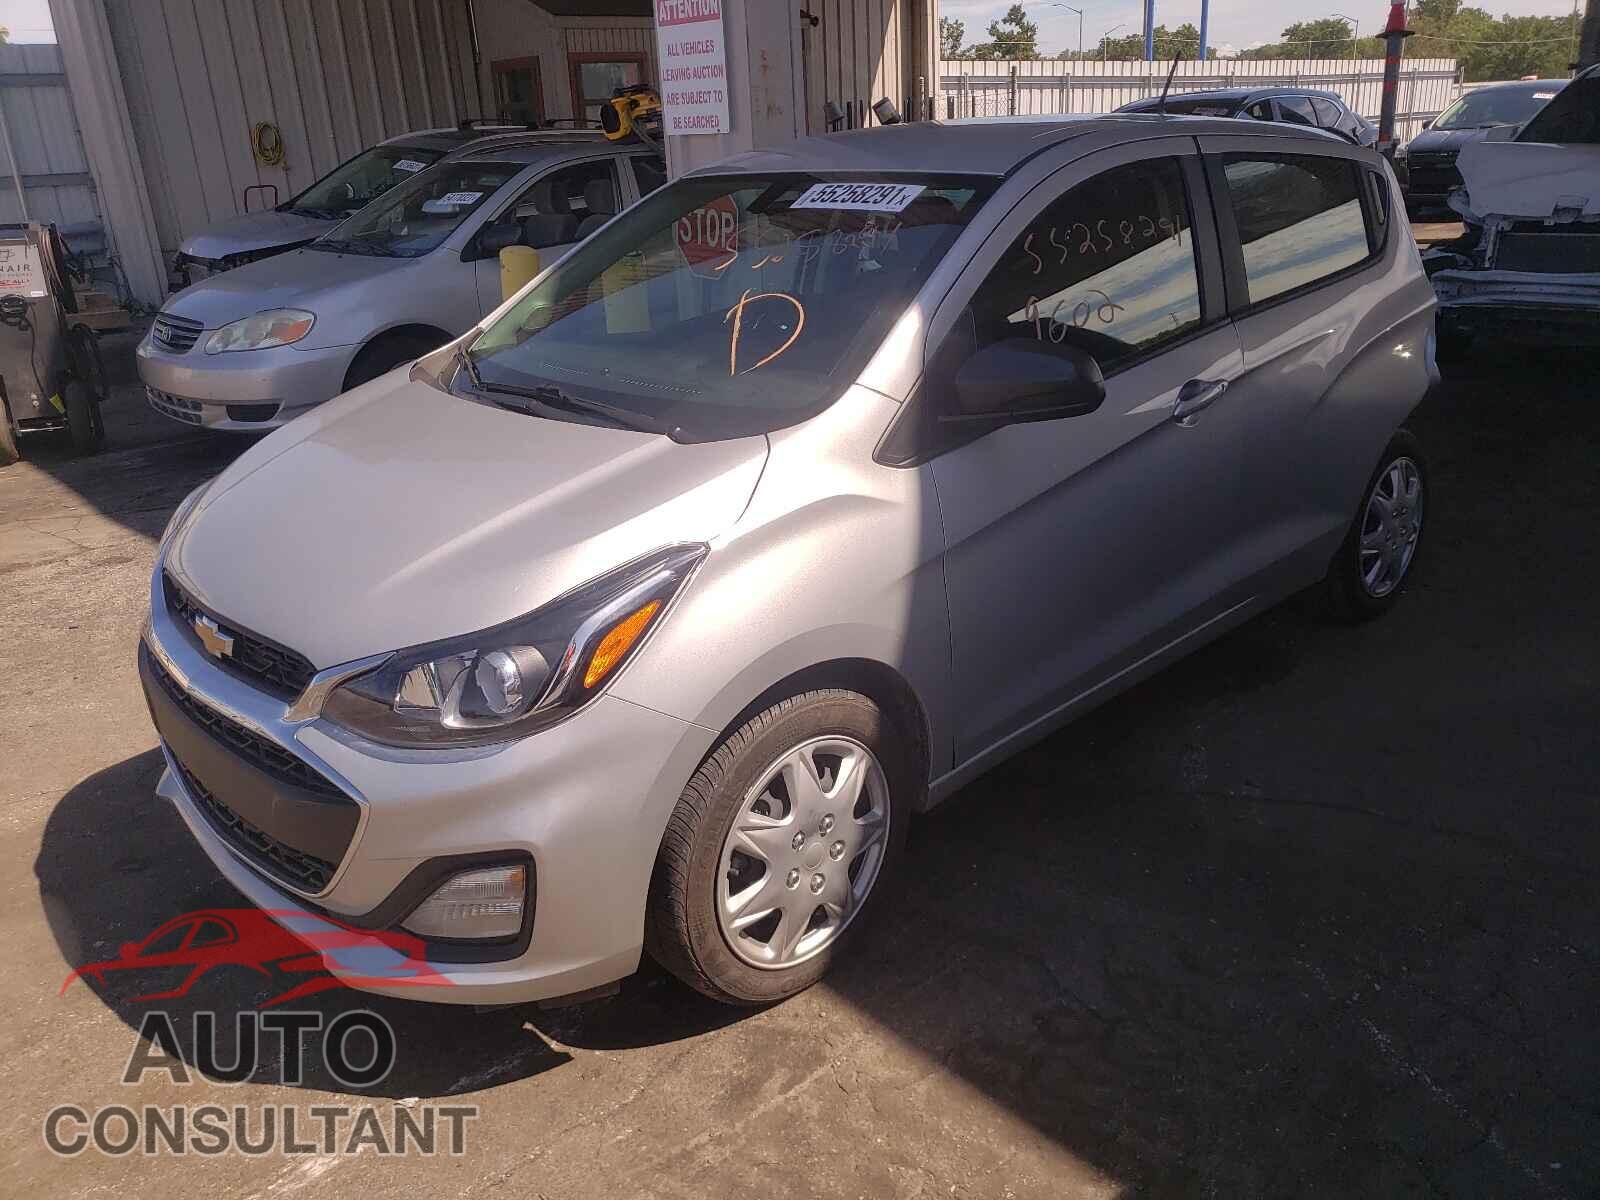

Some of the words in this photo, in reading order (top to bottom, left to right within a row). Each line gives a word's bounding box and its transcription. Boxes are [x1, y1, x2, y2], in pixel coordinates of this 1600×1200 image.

[658, 0, 720, 21] ATTENTION
[667, 43, 680, 57] ALL
[680, 40, 715, 56] VEHICLES
[662, 66, 691, 82] LEAVING
[692, 63, 724, 80] AUCTION
[666, 92, 680, 105] ARE
[681, 91, 712, 105] SUBJECT
[713, 90, 723, 103] TO
[672, 116, 683, 129] BE
[683, 114, 720, 129] SEARCHED
[810, 184, 906, 205] 55258291
[679, 208, 735, 249] STOP
[1023, 214, 1182, 275] 55258291
[1024, 289, 1125, 344] 9602
